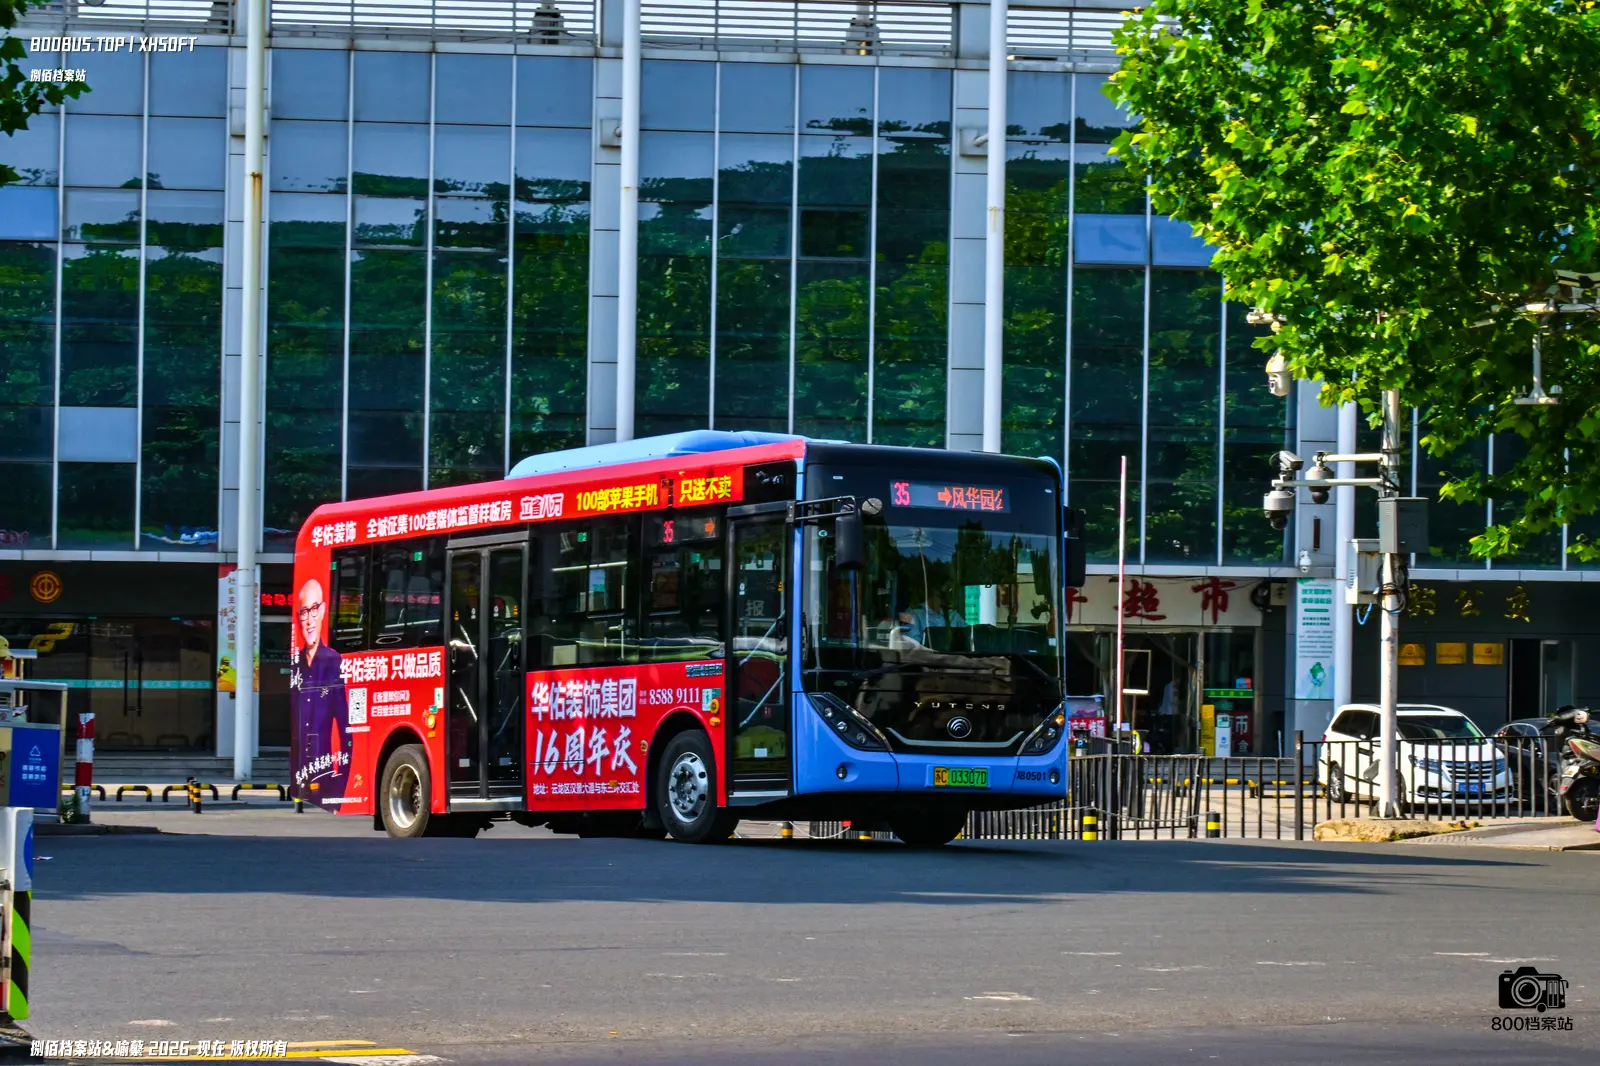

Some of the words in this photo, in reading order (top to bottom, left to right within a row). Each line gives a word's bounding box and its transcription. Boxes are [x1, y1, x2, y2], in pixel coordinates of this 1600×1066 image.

[893, 482, 911, 506] 35
[311, 521, 357, 547] 华佑装饰
[366, 500, 512, 538] 全城征集100套媒体监督样板房
[521, 493, 565, 520] 立省八万
[576, 484, 658, 511] 100部苹果手机
[679, 475, 732, 502] 只送不卖
[339, 657, 388, 684] 华佑装饰
[391, 651, 441, 680] 只做品质
[531, 678, 637, 721] 华佑装饰集团
[649, 688, 674, 705] 8588
[676, 687, 700, 704] 9111
[914, 701, 1005, 711] YUTONG
[533, 724, 638, 776] 16周年庆
